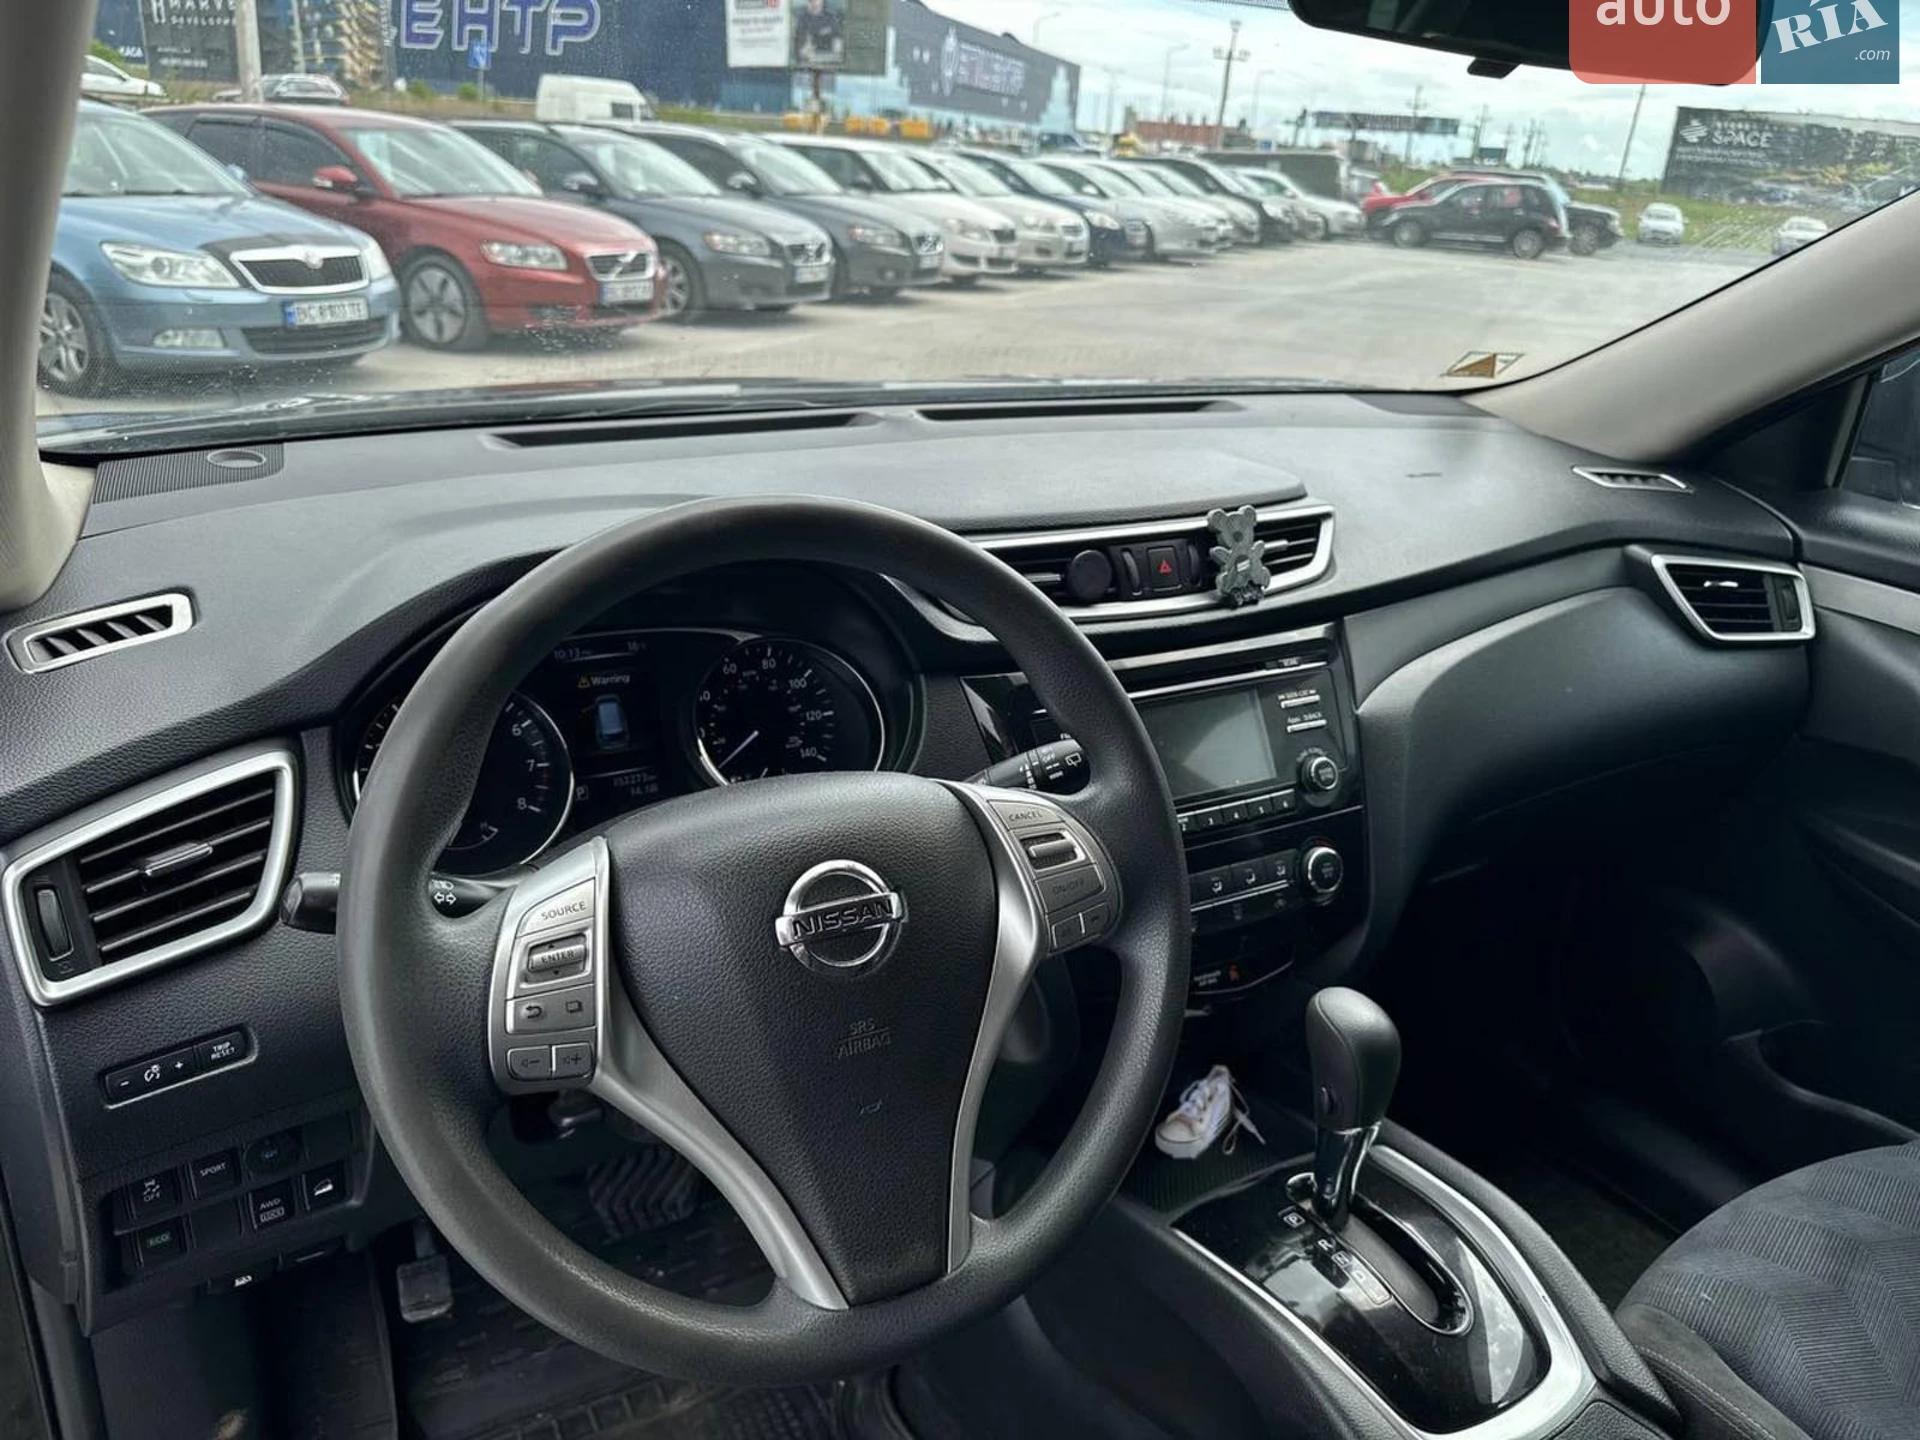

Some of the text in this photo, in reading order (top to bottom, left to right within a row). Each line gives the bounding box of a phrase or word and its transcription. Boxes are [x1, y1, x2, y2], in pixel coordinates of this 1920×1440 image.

[1712, 130, 1774, 148] SPACE
[722, 663, 737, 676] 60
[761, 657, 776, 670] 80
[590, 674, 631, 686] Warning
[789, 677, 808, 690] 100
[806, 709, 823, 721] 120
[511, 726, 522, 737] 6
[800, 747, 818, 760] 140
[527, 759, 536, 772] 7
[517, 797, 528, 811] 8
[1008, 810, 1043, 822] CANCEL
[541, 901, 587, 920] SOURCE
[792, 899, 894, 938] NISSAN
[541, 950, 575, 964] ENTER
[849, 1017, 876, 1035] SRS
[838, 1033, 892, 1059] AIRBAG
[200, 1162, 228, 1177] SPORT
[143, 1190, 161, 1203] OFF
[258, 1197, 282, 1211] AWD
